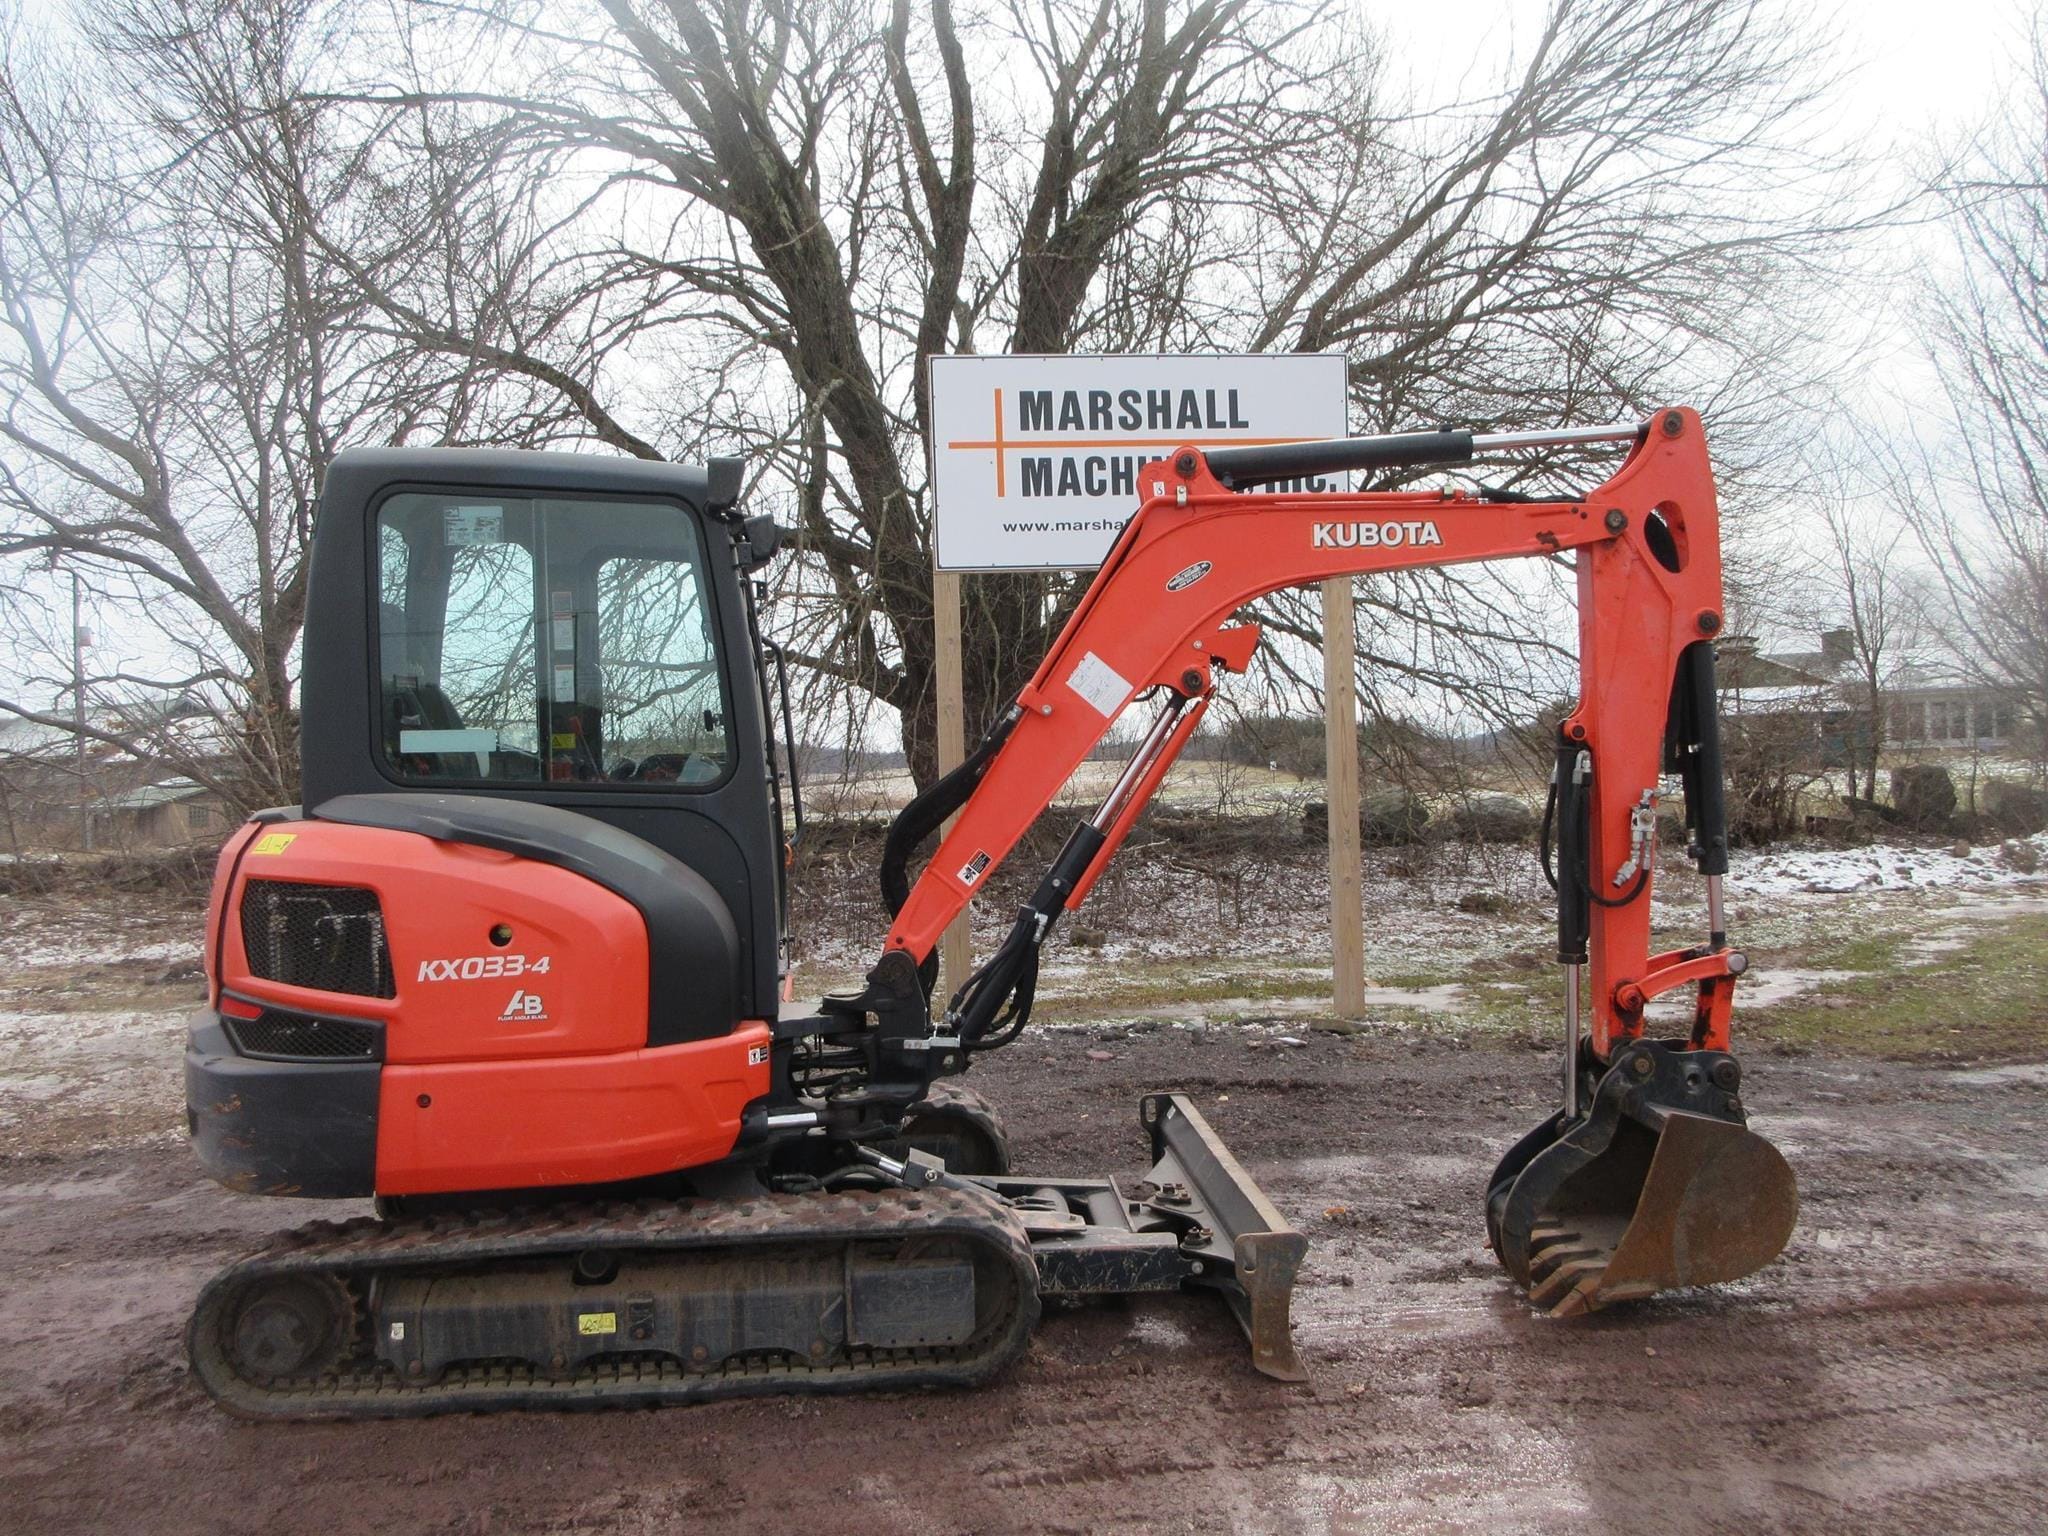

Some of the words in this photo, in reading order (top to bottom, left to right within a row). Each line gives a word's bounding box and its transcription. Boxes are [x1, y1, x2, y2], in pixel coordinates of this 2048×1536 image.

[1019, 389, 1249, 431] MARSHALL
[1021, 455, 1172, 497] MACH
[1003, 519, 1128, 532] www.marsha
[1312, 521, 1442, 548] KUBOTA
[417, 954, 550, 982] KX033-4
